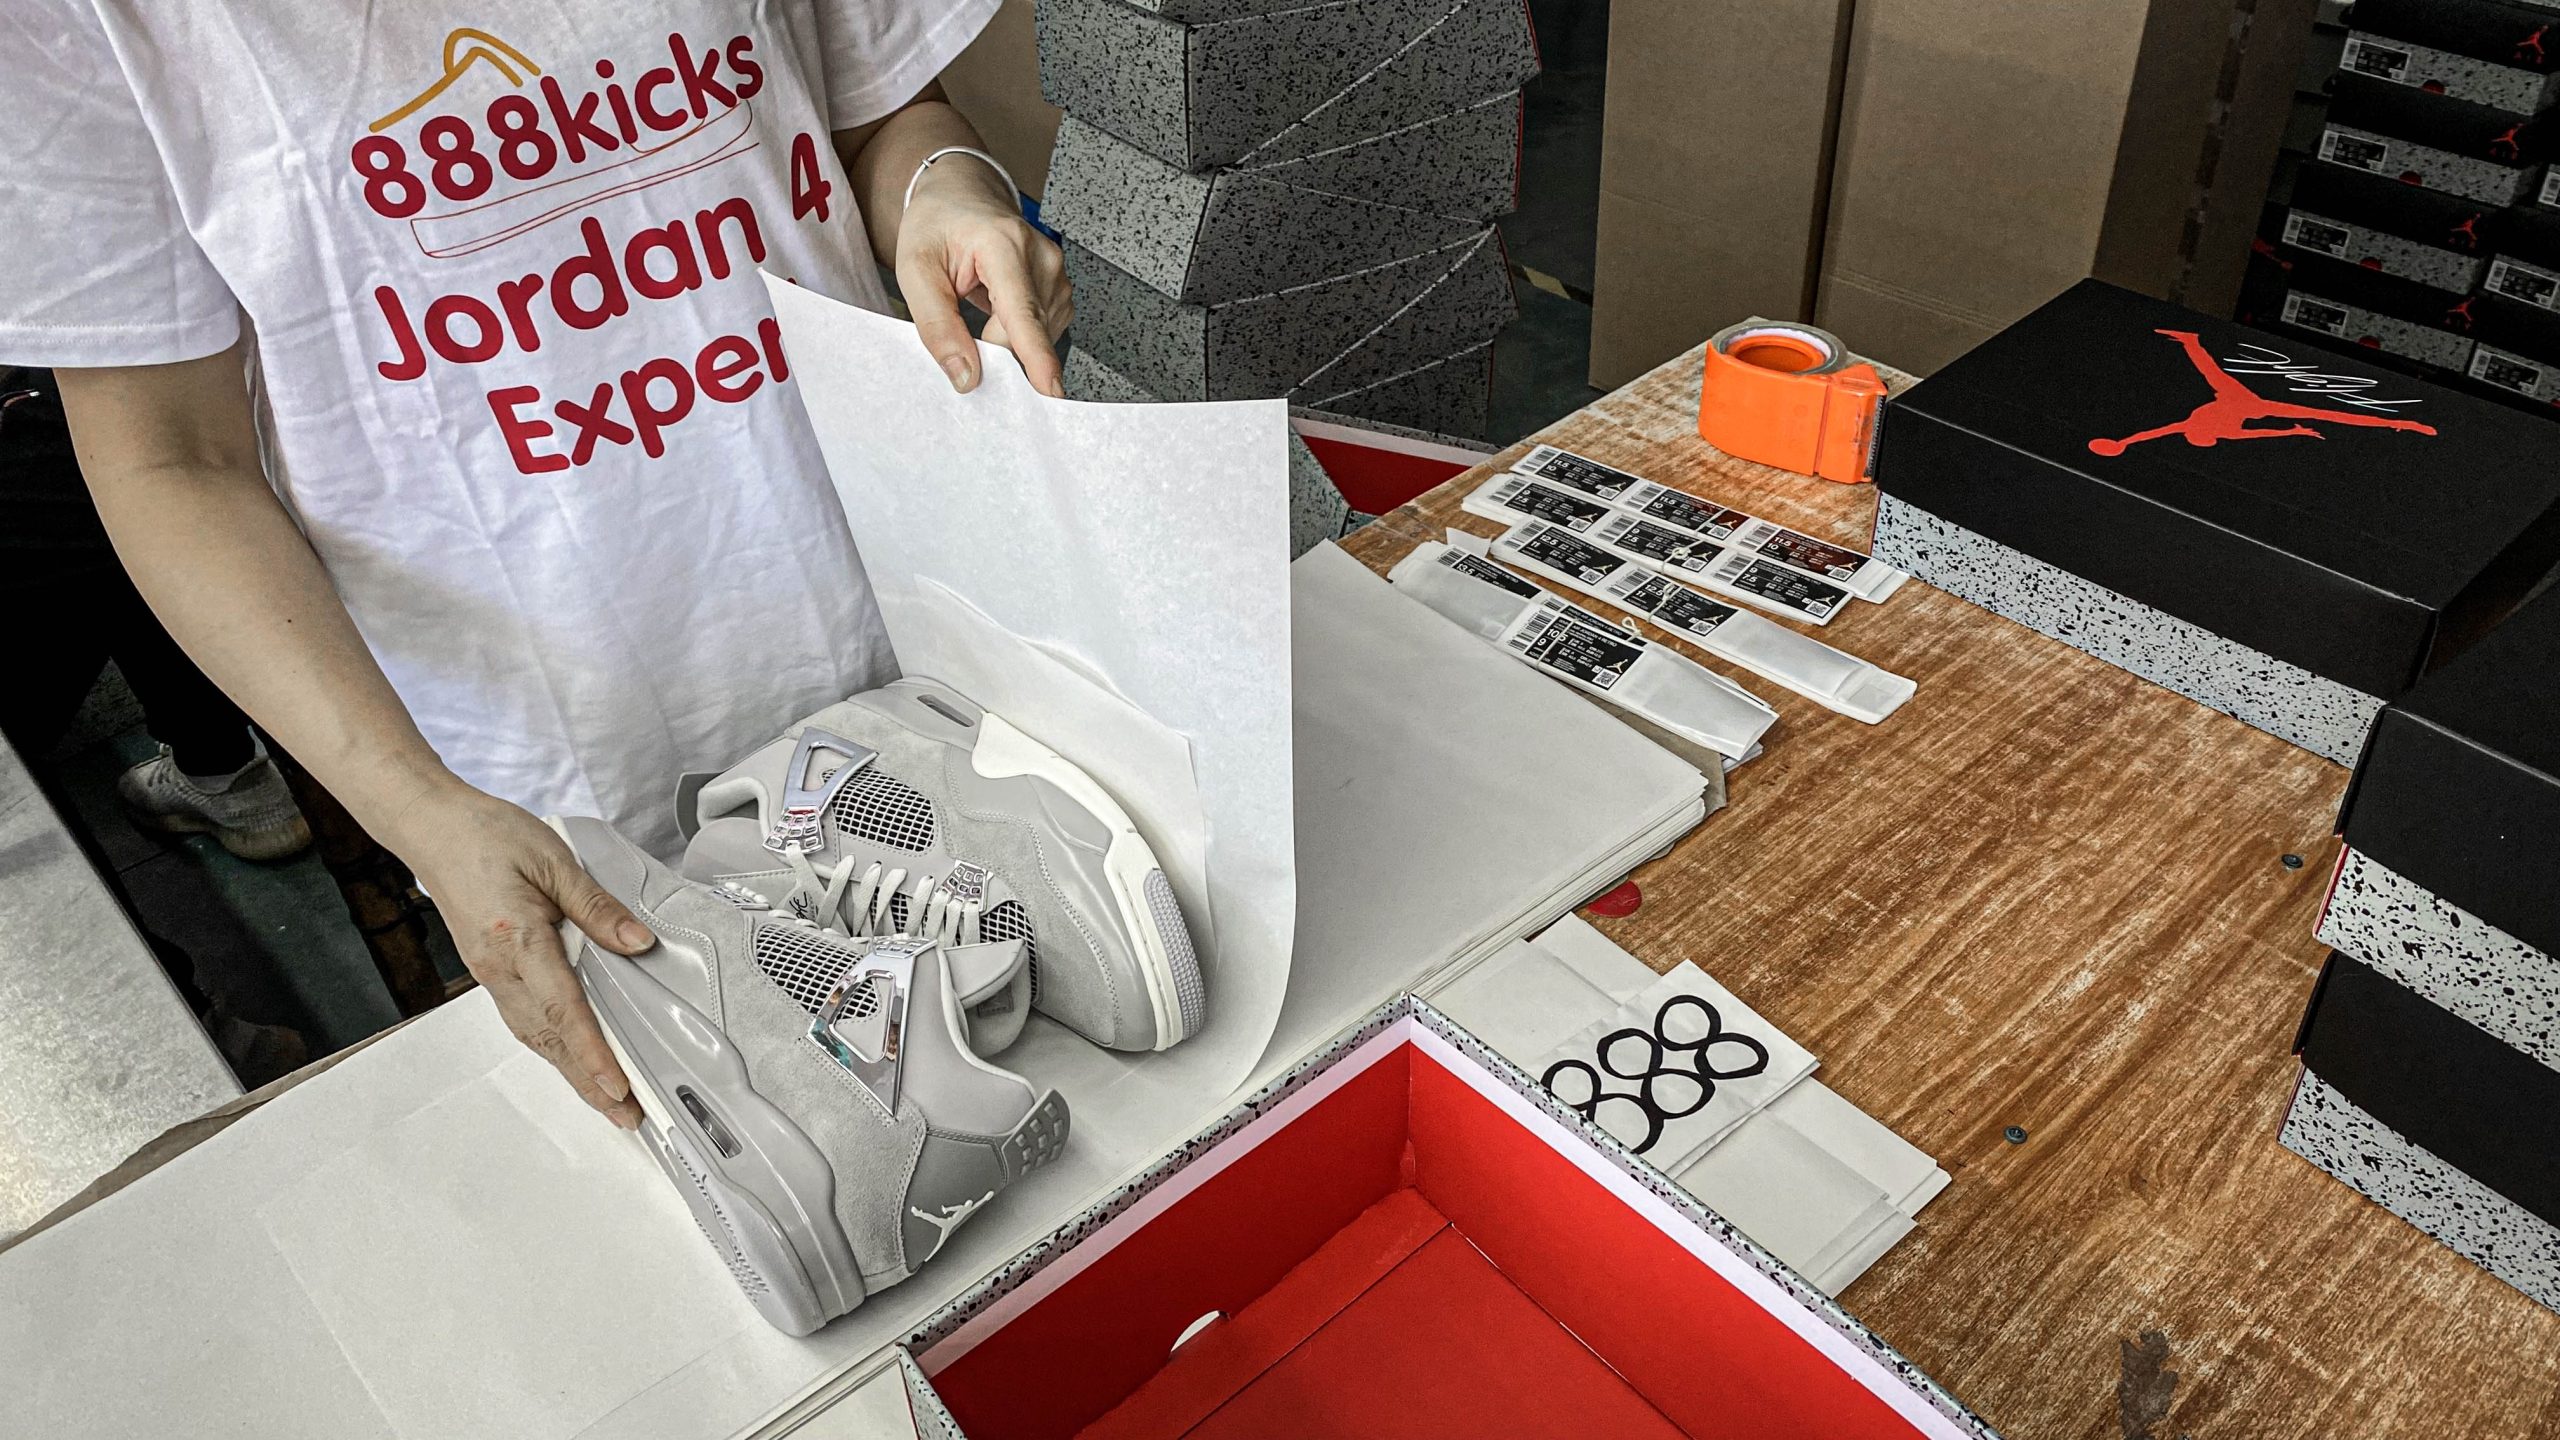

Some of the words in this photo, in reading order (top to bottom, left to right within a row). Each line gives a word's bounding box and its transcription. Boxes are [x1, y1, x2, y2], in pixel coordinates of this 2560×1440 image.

[351, 33, 764, 219] 888kicks
[375, 198, 767, 381] Jordan
[791, 132, 832, 223] 4
[487, 280, 797, 475] Exper
[1553, 459, 1570, 468] 11.5
[1659, 496, 1677, 505] 11.5
[1539, 534, 1559, 545] 12.5
[1624, 533, 1639, 543] 7.5
[1774, 536, 1792, 546] 11.5
[1531, 540, 1541, 548] 11
[1767, 542, 1779, 550] 10
[1742, 573, 1758, 583] 7.5
[1645, 584, 1664, 596] 12.5
[1537, 637, 1547, 646] 9
[1540, 994, 1770, 1155] 888
